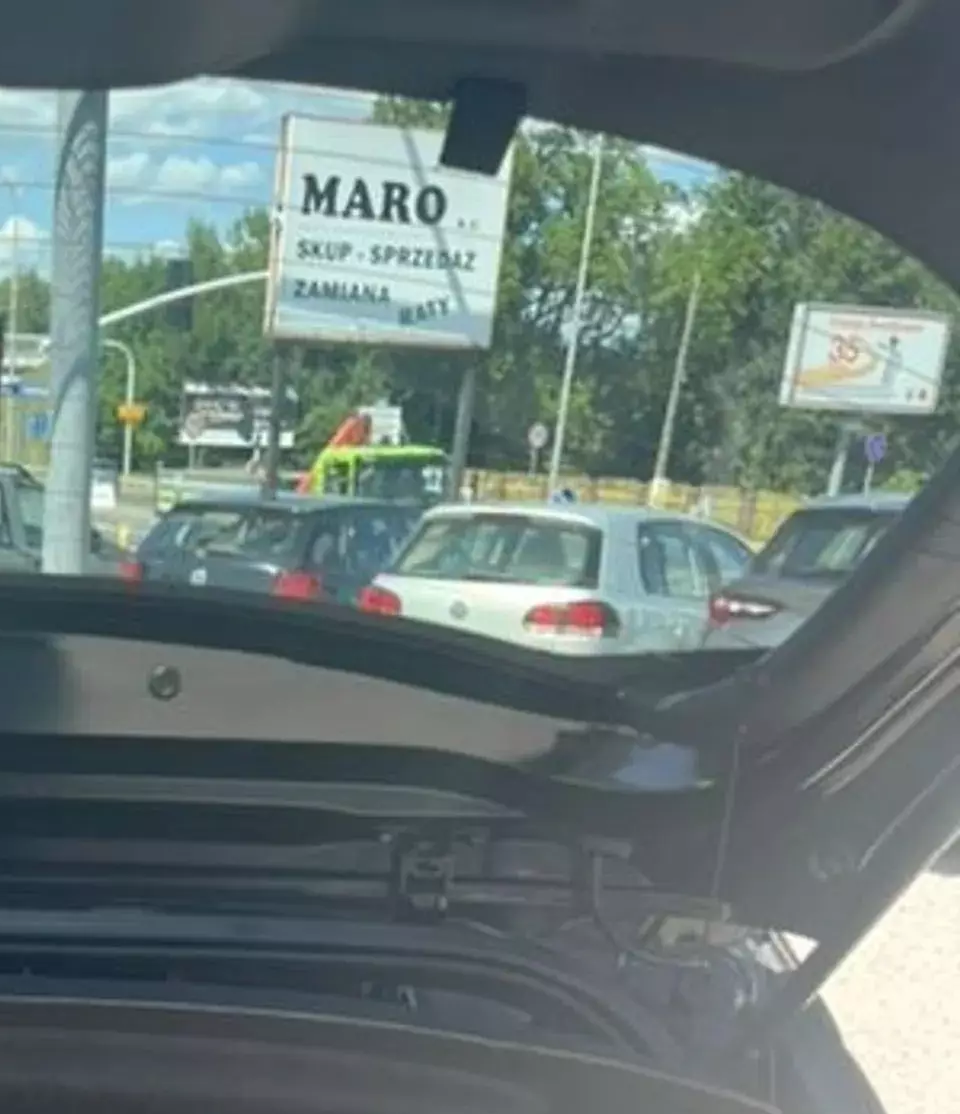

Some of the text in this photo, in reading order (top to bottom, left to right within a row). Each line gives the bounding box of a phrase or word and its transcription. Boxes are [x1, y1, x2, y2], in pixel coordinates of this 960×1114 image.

[301, 173, 448, 225] MARO
[296, 239, 353, 262] SKUP
[293, 279, 391, 303] ZAMIANA
